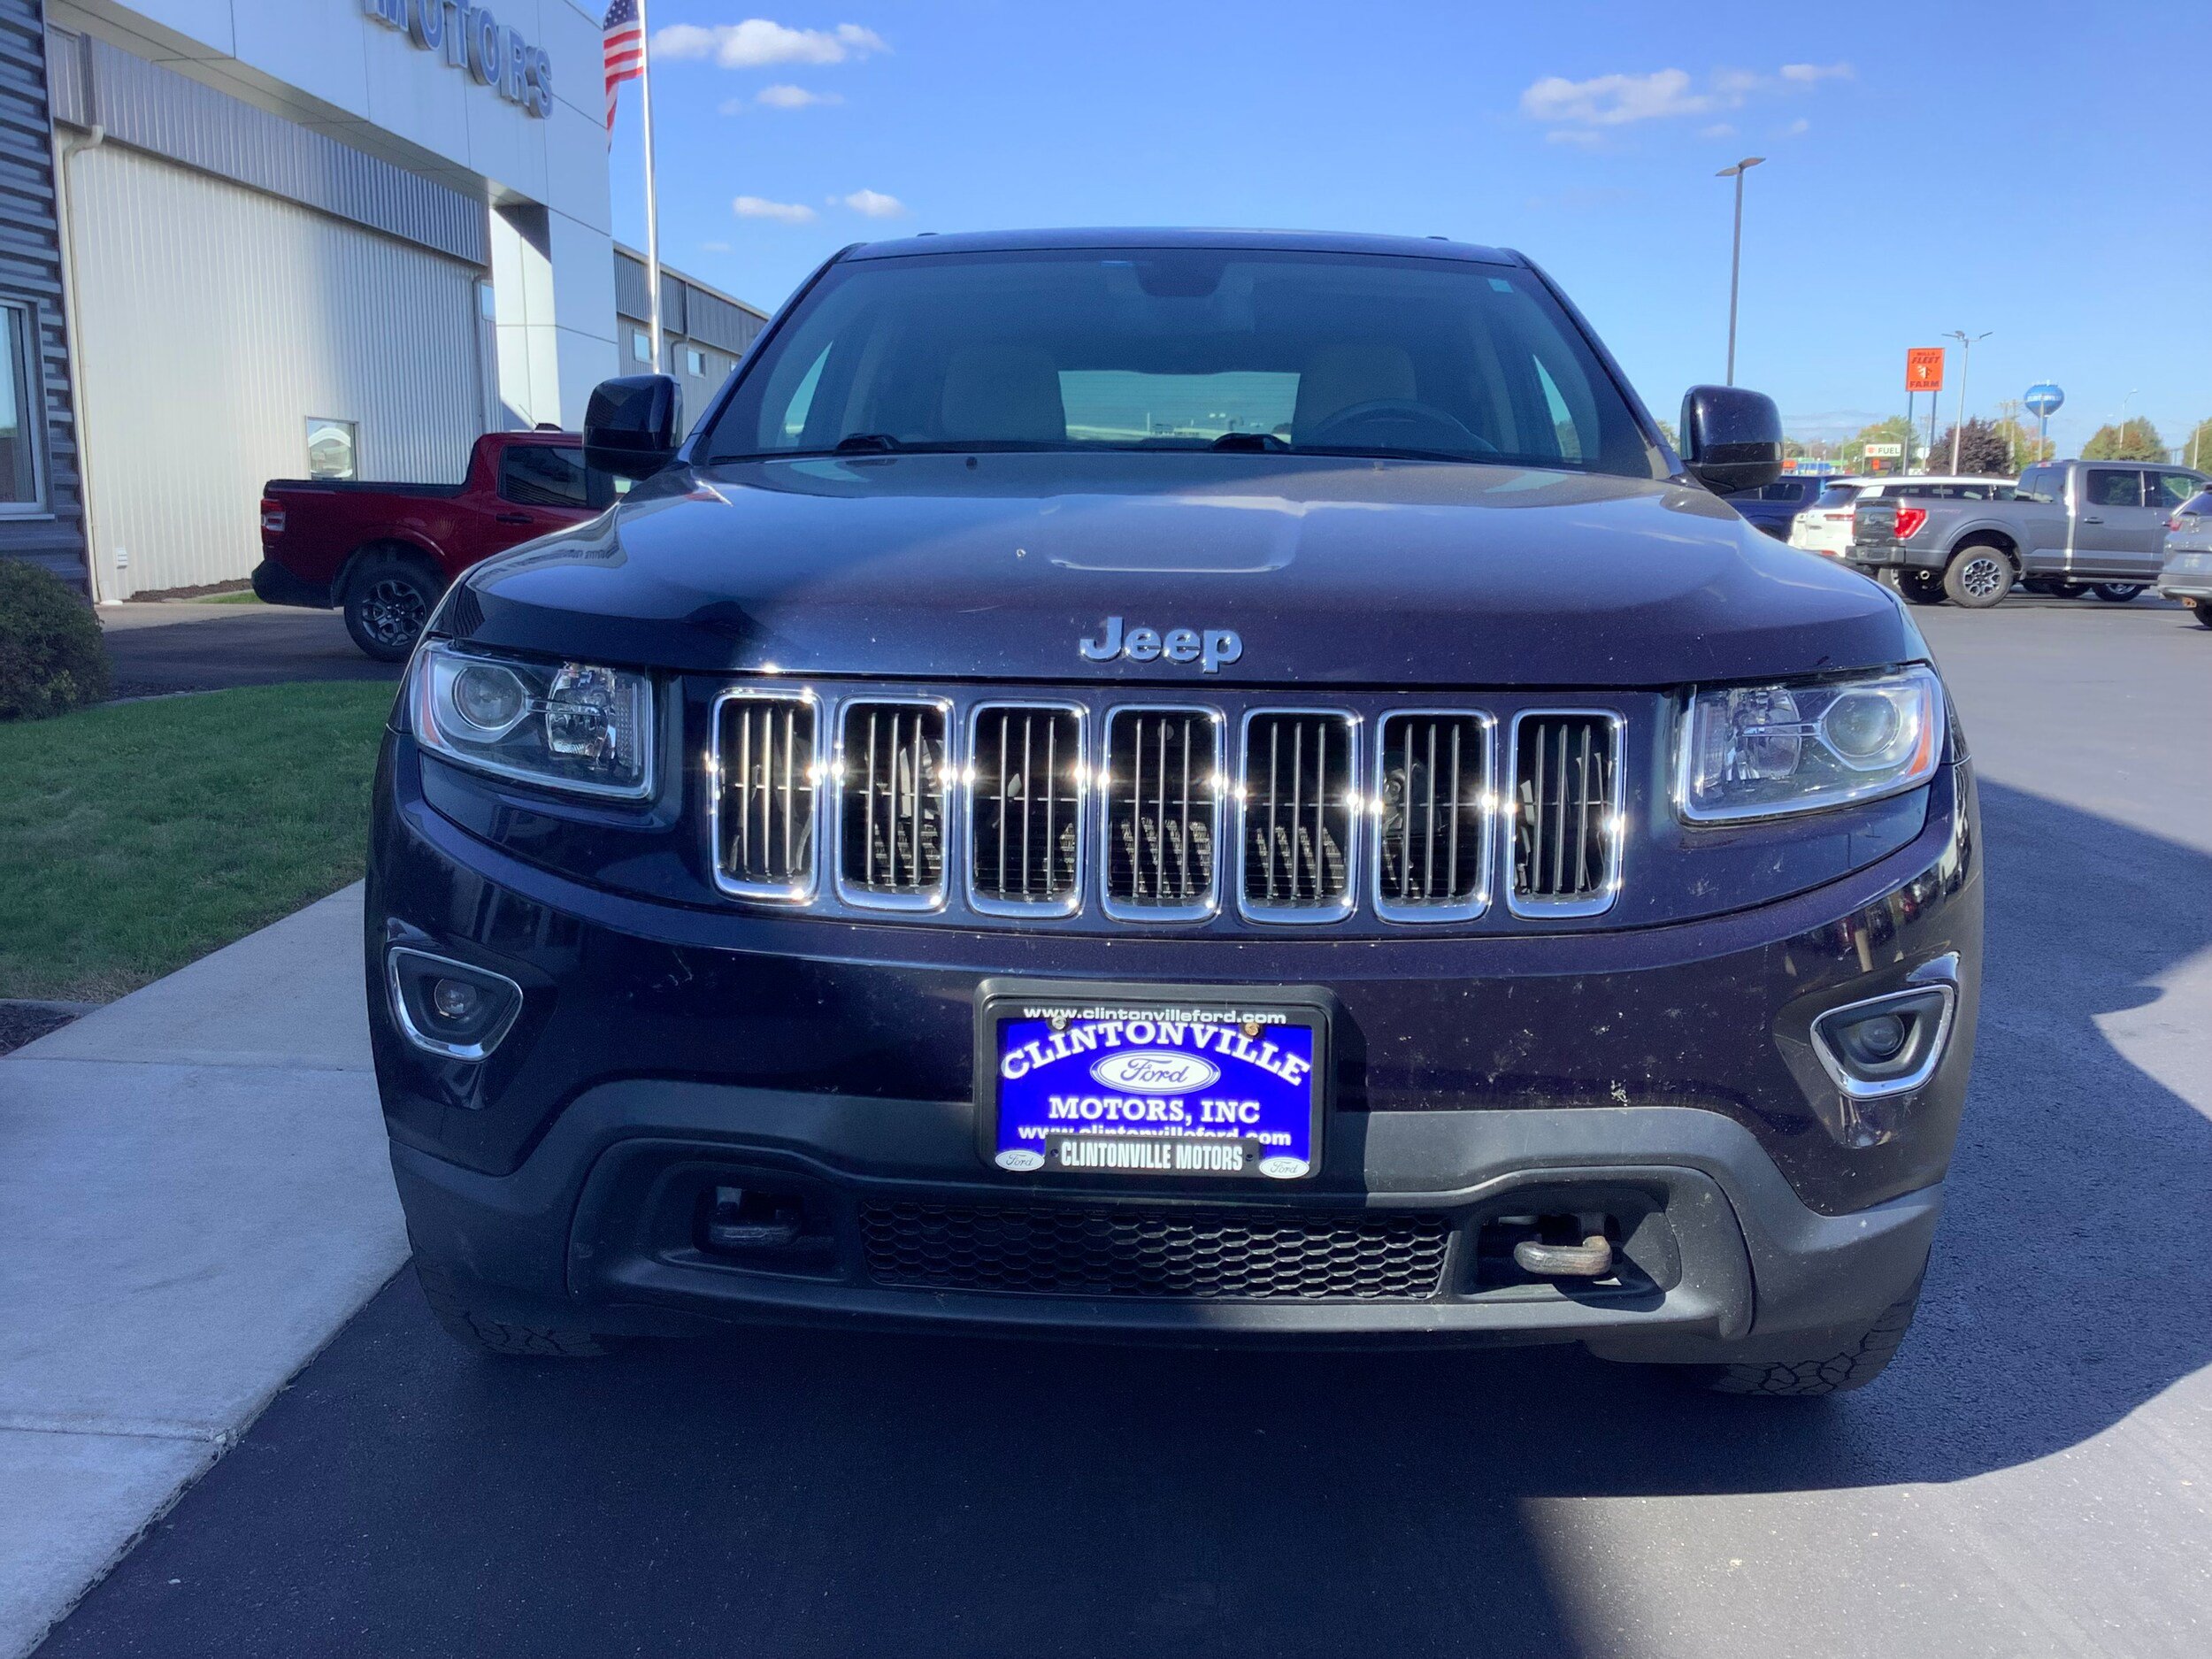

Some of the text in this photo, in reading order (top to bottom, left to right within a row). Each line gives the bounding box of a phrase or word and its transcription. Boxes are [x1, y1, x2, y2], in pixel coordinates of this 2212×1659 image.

[1079, 617, 1243, 674] Jeep
[1023, 1007, 1287, 1025] www.clintonvilleford.com
[1001, 1021, 1310, 1087] CLINTONVILLE
[1119, 1058, 1189, 1083] Ford
[1048, 1096, 1261, 1126] MOTORS, INC
[1018, 1125, 1292, 1147] wwlitillfdom
[1005, 1153, 1034, 1166] Ford
[1061, 1141, 1243, 1171] CLINTONVILLE MOTORS
[1270, 1160, 1299, 1174] Ford
